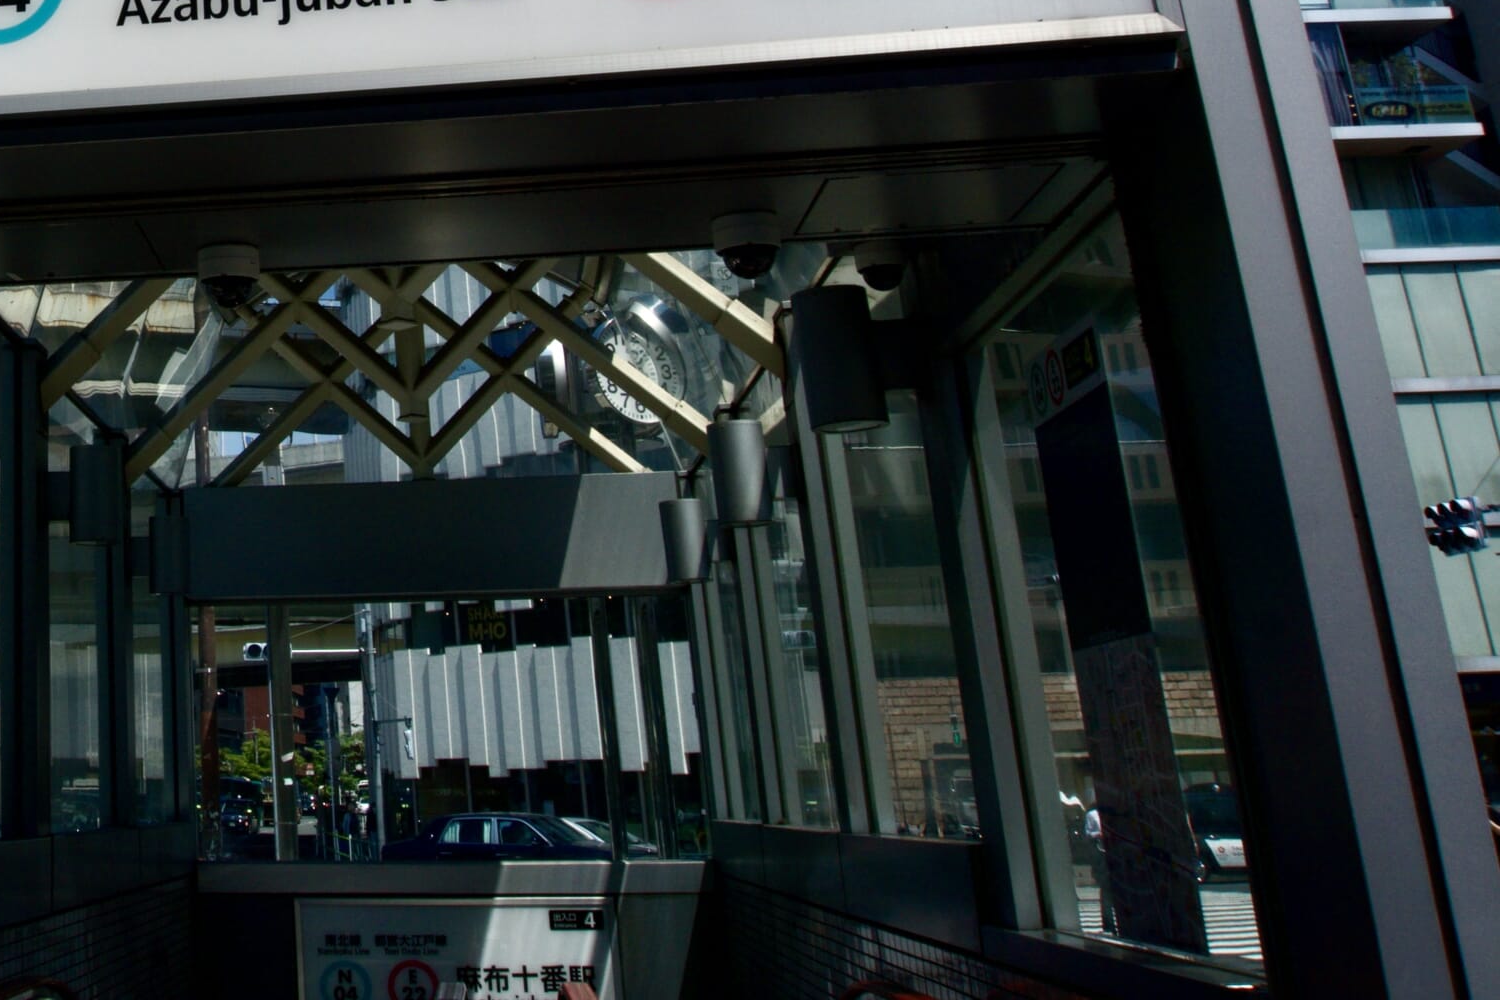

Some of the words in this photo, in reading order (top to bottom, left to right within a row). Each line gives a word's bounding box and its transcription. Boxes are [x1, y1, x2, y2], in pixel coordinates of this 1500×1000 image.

[584, 911, 597, 928] 4
[338, 969, 352, 984] N
[409, 969, 418, 984] E
[457, 965, 596, 993] 麻布十番駅
[334, 986, 358, 1000] 04
[402, 986, 427, 1000] 22
